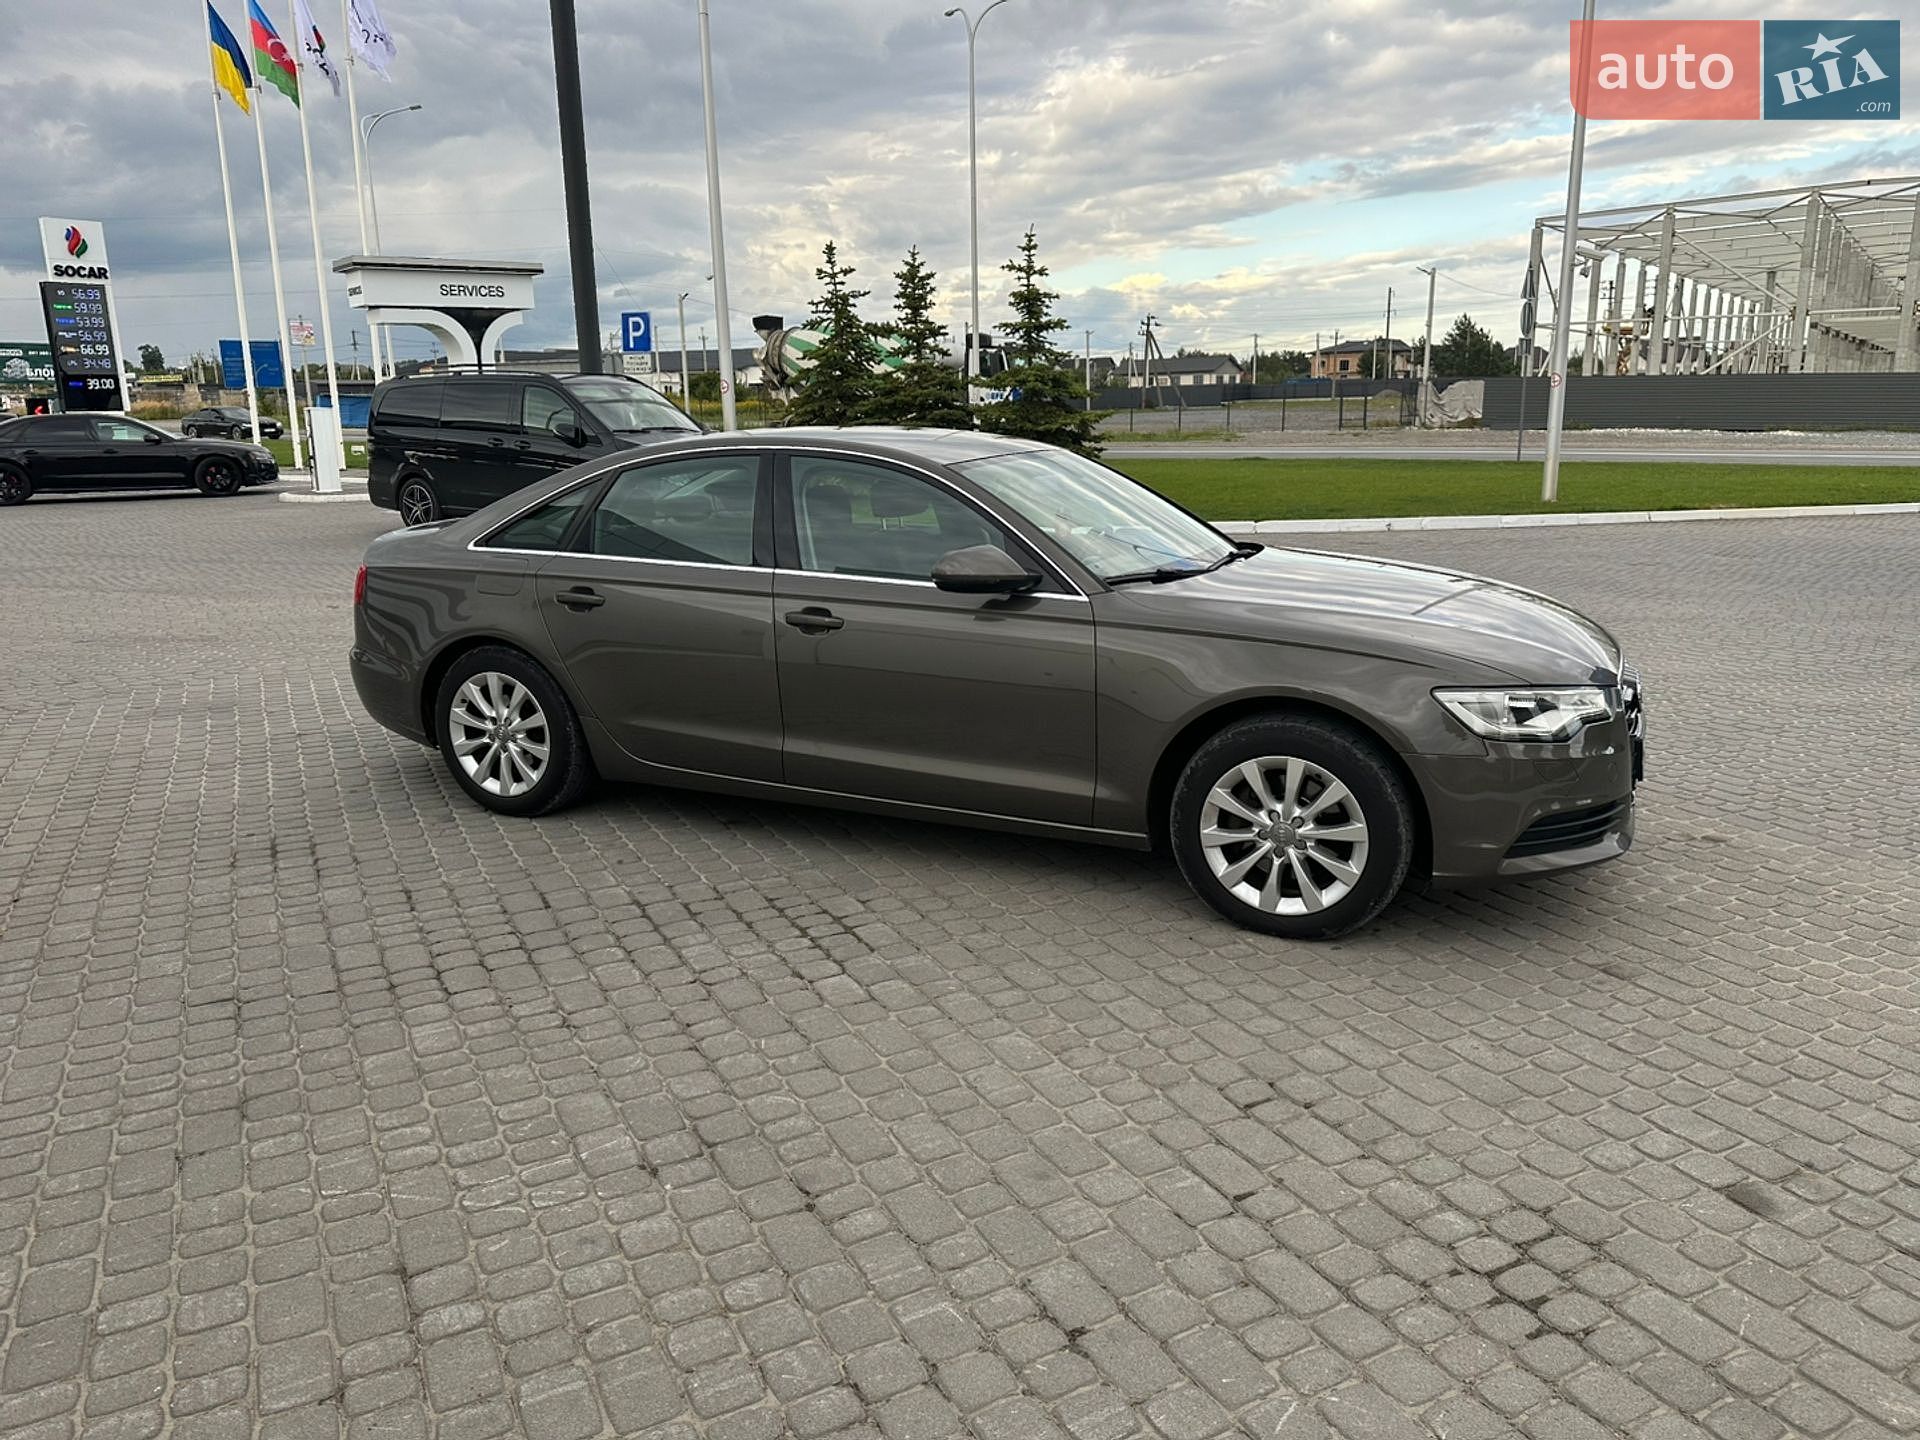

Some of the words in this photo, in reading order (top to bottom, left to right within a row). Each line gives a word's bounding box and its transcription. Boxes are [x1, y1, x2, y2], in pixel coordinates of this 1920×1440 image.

[53, 264, 109, 280] SOCAR
[439, 284, 505, 298] SERVICES
[628, 317, 645, 348] P
[80, 344, 110, 355] 66.99
[86, 378, 115, 390] 39.00
